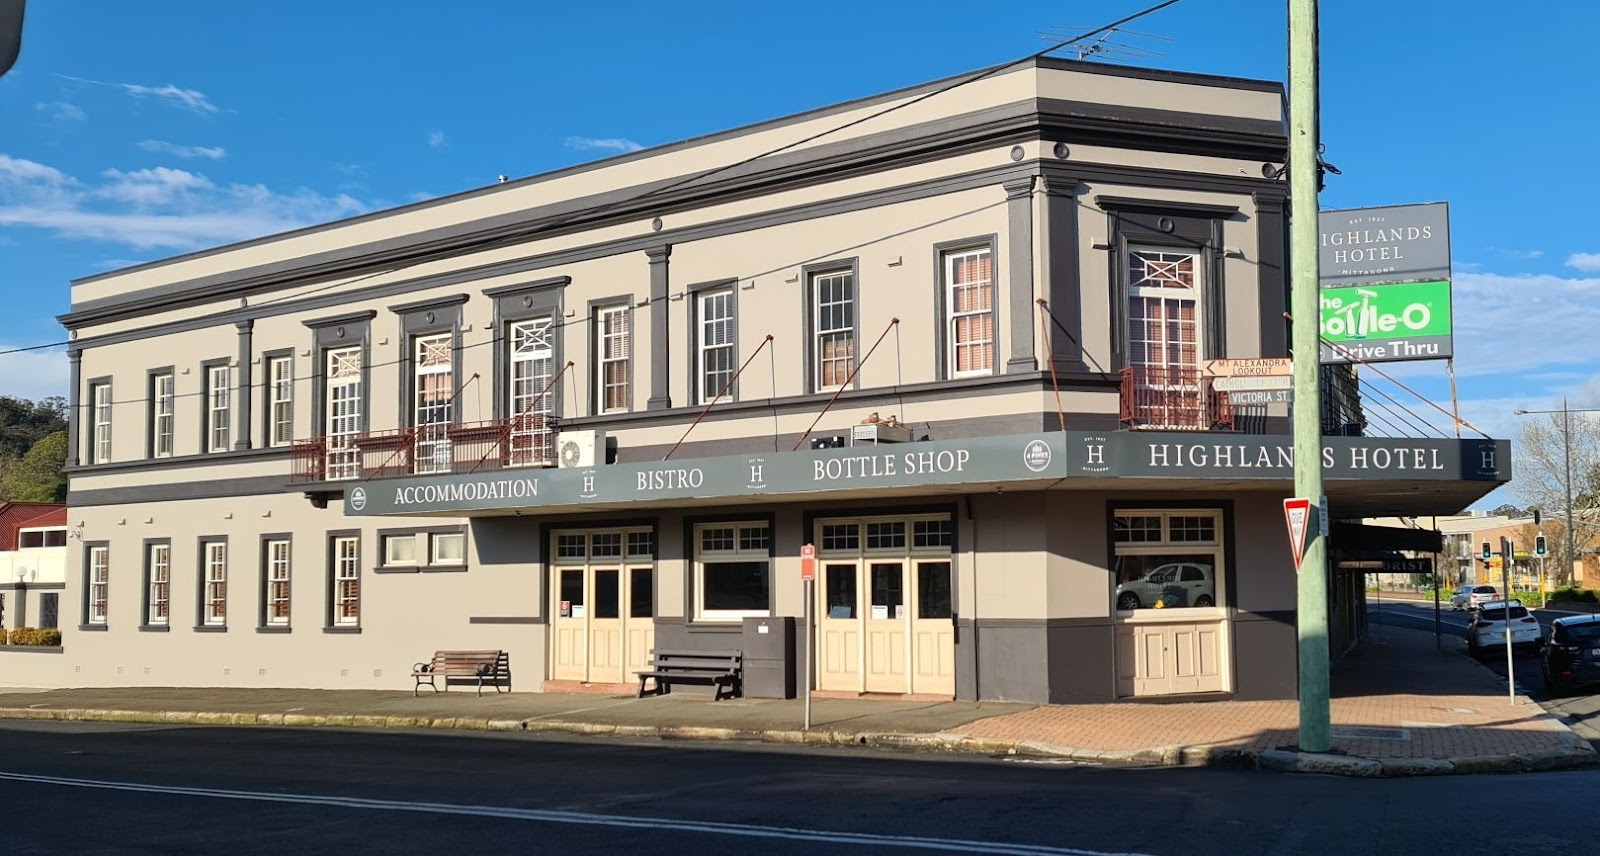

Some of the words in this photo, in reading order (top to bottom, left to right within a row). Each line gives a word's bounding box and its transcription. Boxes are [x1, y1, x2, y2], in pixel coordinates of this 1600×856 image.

[1321, 226, 1432, 246] IGHLANDS
[1335, 246, 1403, 263] HOTEL
[1342, 266, 1395, 275] MITTAGONG
[1320, 293, 1343, 309] he
[1332, 343, 1386, 360] Drive
[1388, 340, 1439, 357] Thru
[1232, 367, 1273, 375] LOOKOUT
[1233, 359, 1287, 368] ALEXANDRA
[1231, 391, 1273, 403] VICTORIA
[1276, 391, 1288, 401] ST
[1086, 444, 1105, 464] H
[1148, 444, 1335, 468] HIGHLANS
[1350, 447, 1444, 470] HOTEL
[1480, 451, 1496, 469] H
[813, 454, 897, 480] BOTTLE
[904, 449, 970, 475] SHOP
[637, 468, 704, 490] BISTRO
[750, 465, 764, 482] H
[394, 478, 539, 505] ACCOMMODATION
[583, 476, 595, 492] H
[1384, 560, 1426, 571] ORIST
